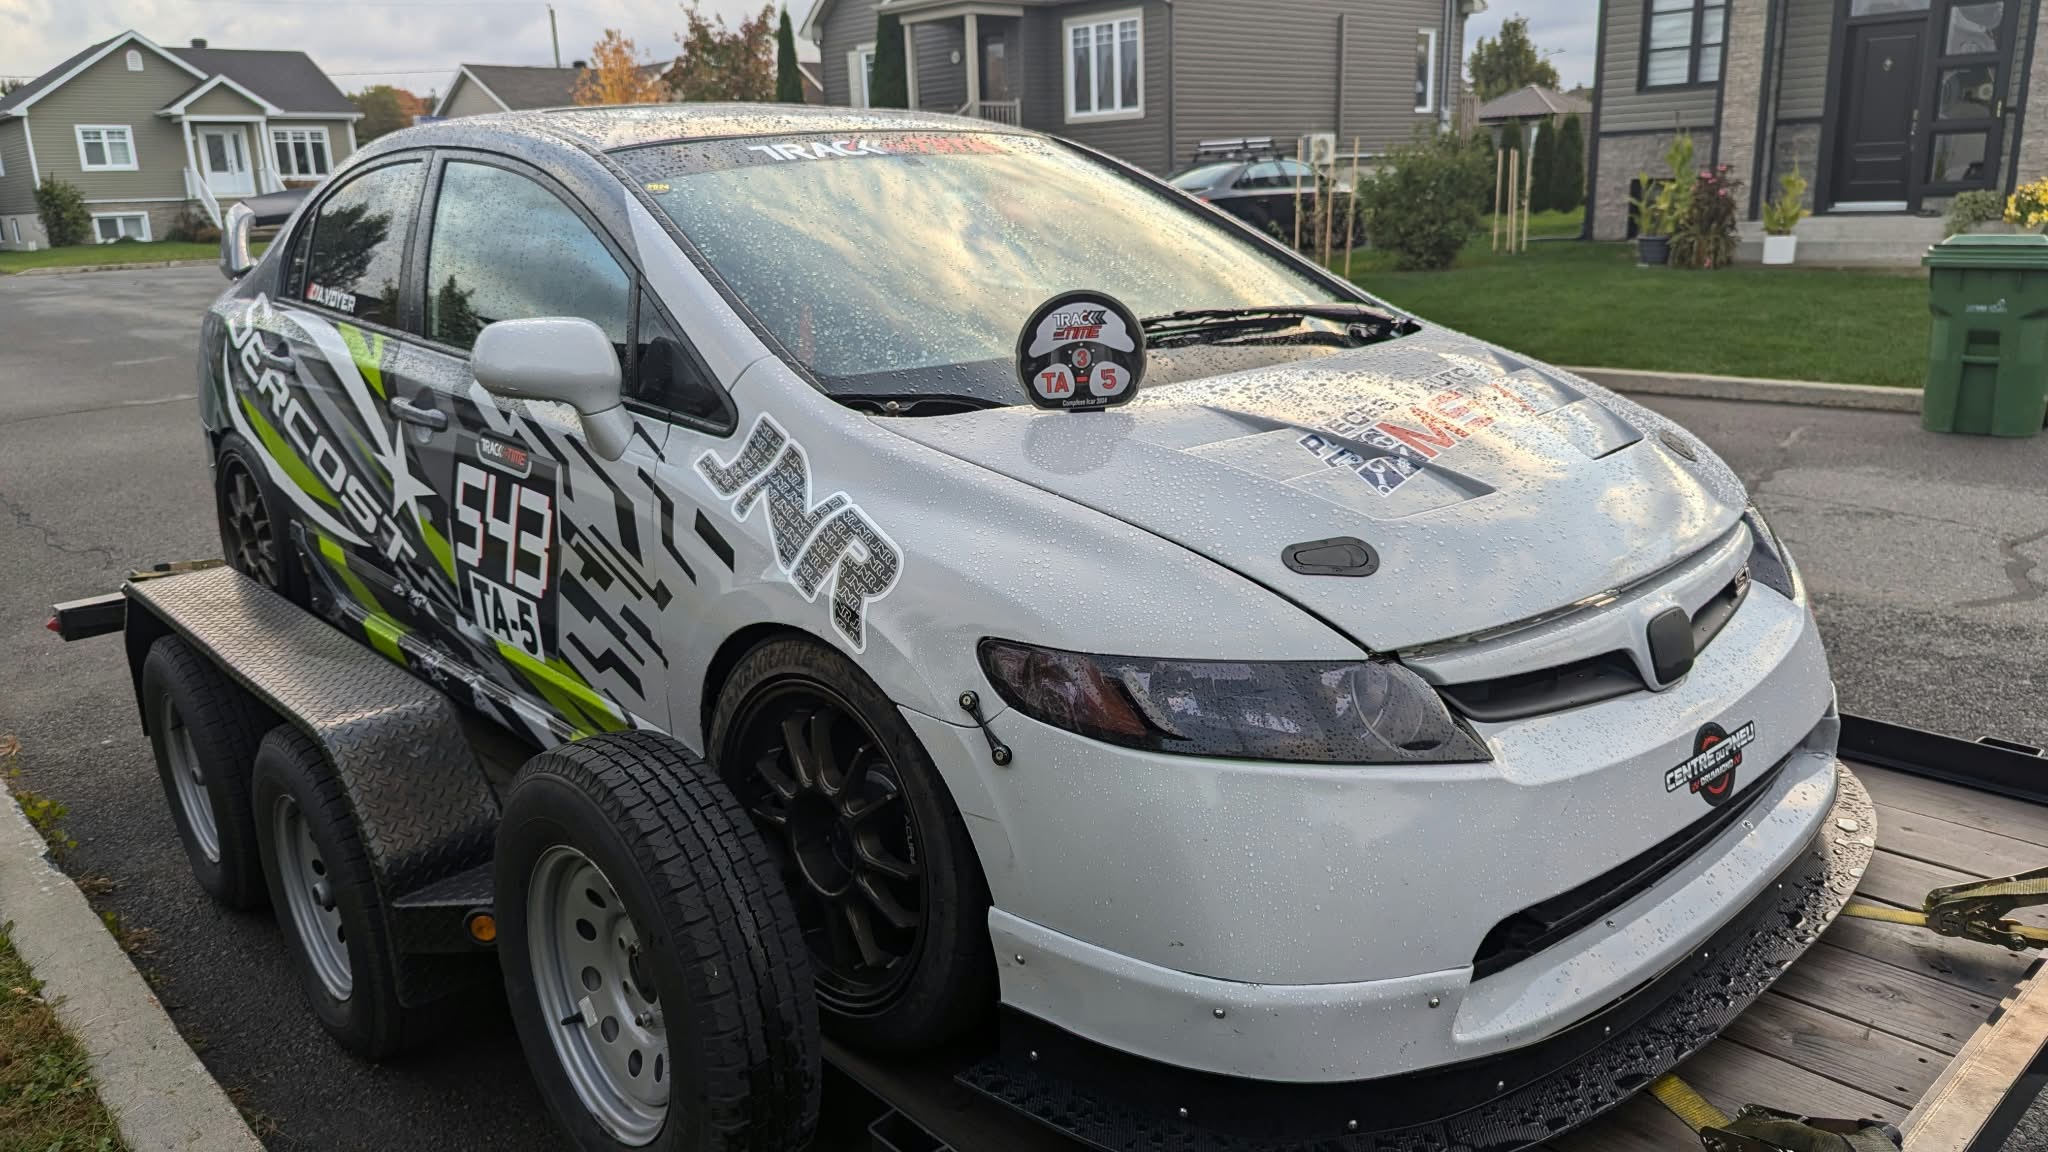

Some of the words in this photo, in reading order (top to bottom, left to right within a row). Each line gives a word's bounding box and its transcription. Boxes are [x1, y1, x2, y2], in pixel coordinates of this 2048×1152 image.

[1041, 372, 1069, 393] TA
[1101, 369, 1117, 389] 5
[1077, 351, 1088, 366] 3
[456, 462, 553, 599] 543
[693, 411, 905, 654] JNR
[472, 574, 540, 657] TA-5
[1666, 750, 1715, 791] CENTRE
[1715, 747, 1726, 762] DU
[1724, 723, 1754, 755] PNEU
